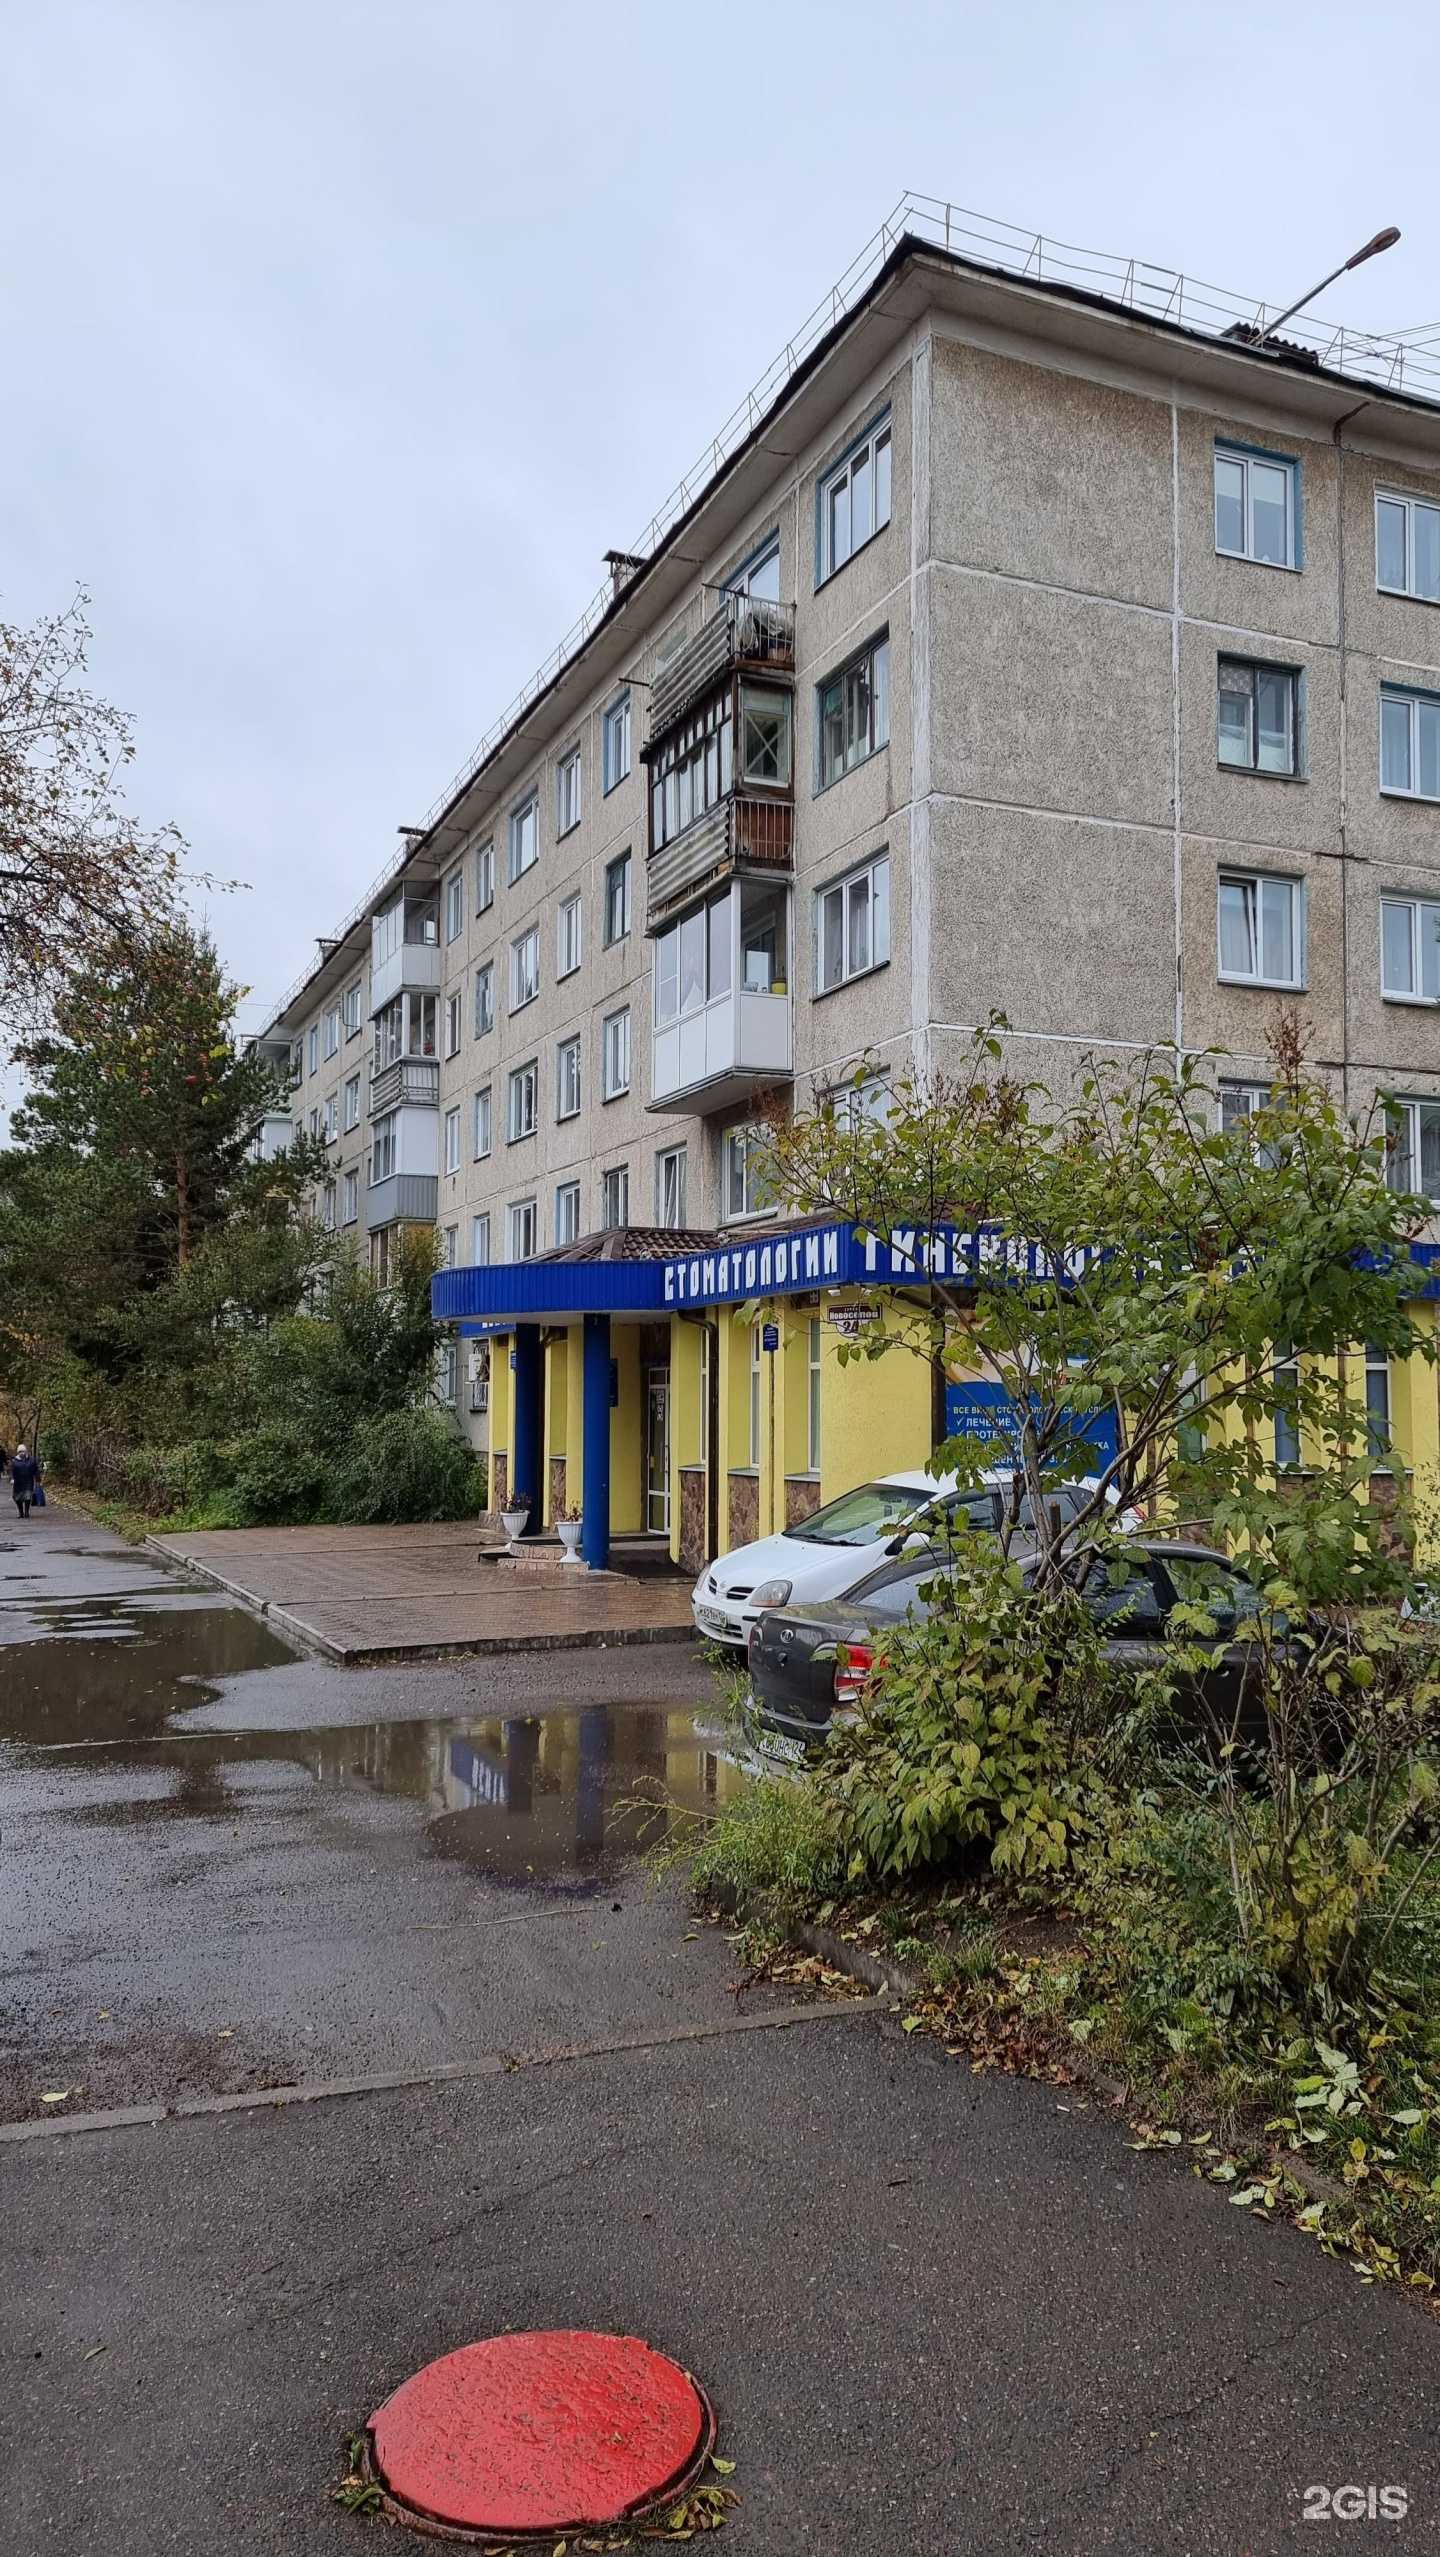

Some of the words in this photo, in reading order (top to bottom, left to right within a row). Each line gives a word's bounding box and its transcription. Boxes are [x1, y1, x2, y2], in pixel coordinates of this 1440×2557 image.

[665, 1231, 838, 1301] СТОМАТОЛОГИИ
[953, 1406, 970, 1414] ВСЕ
[966, 1417, 1011, 1427] ЛЕЧЕИЕ
